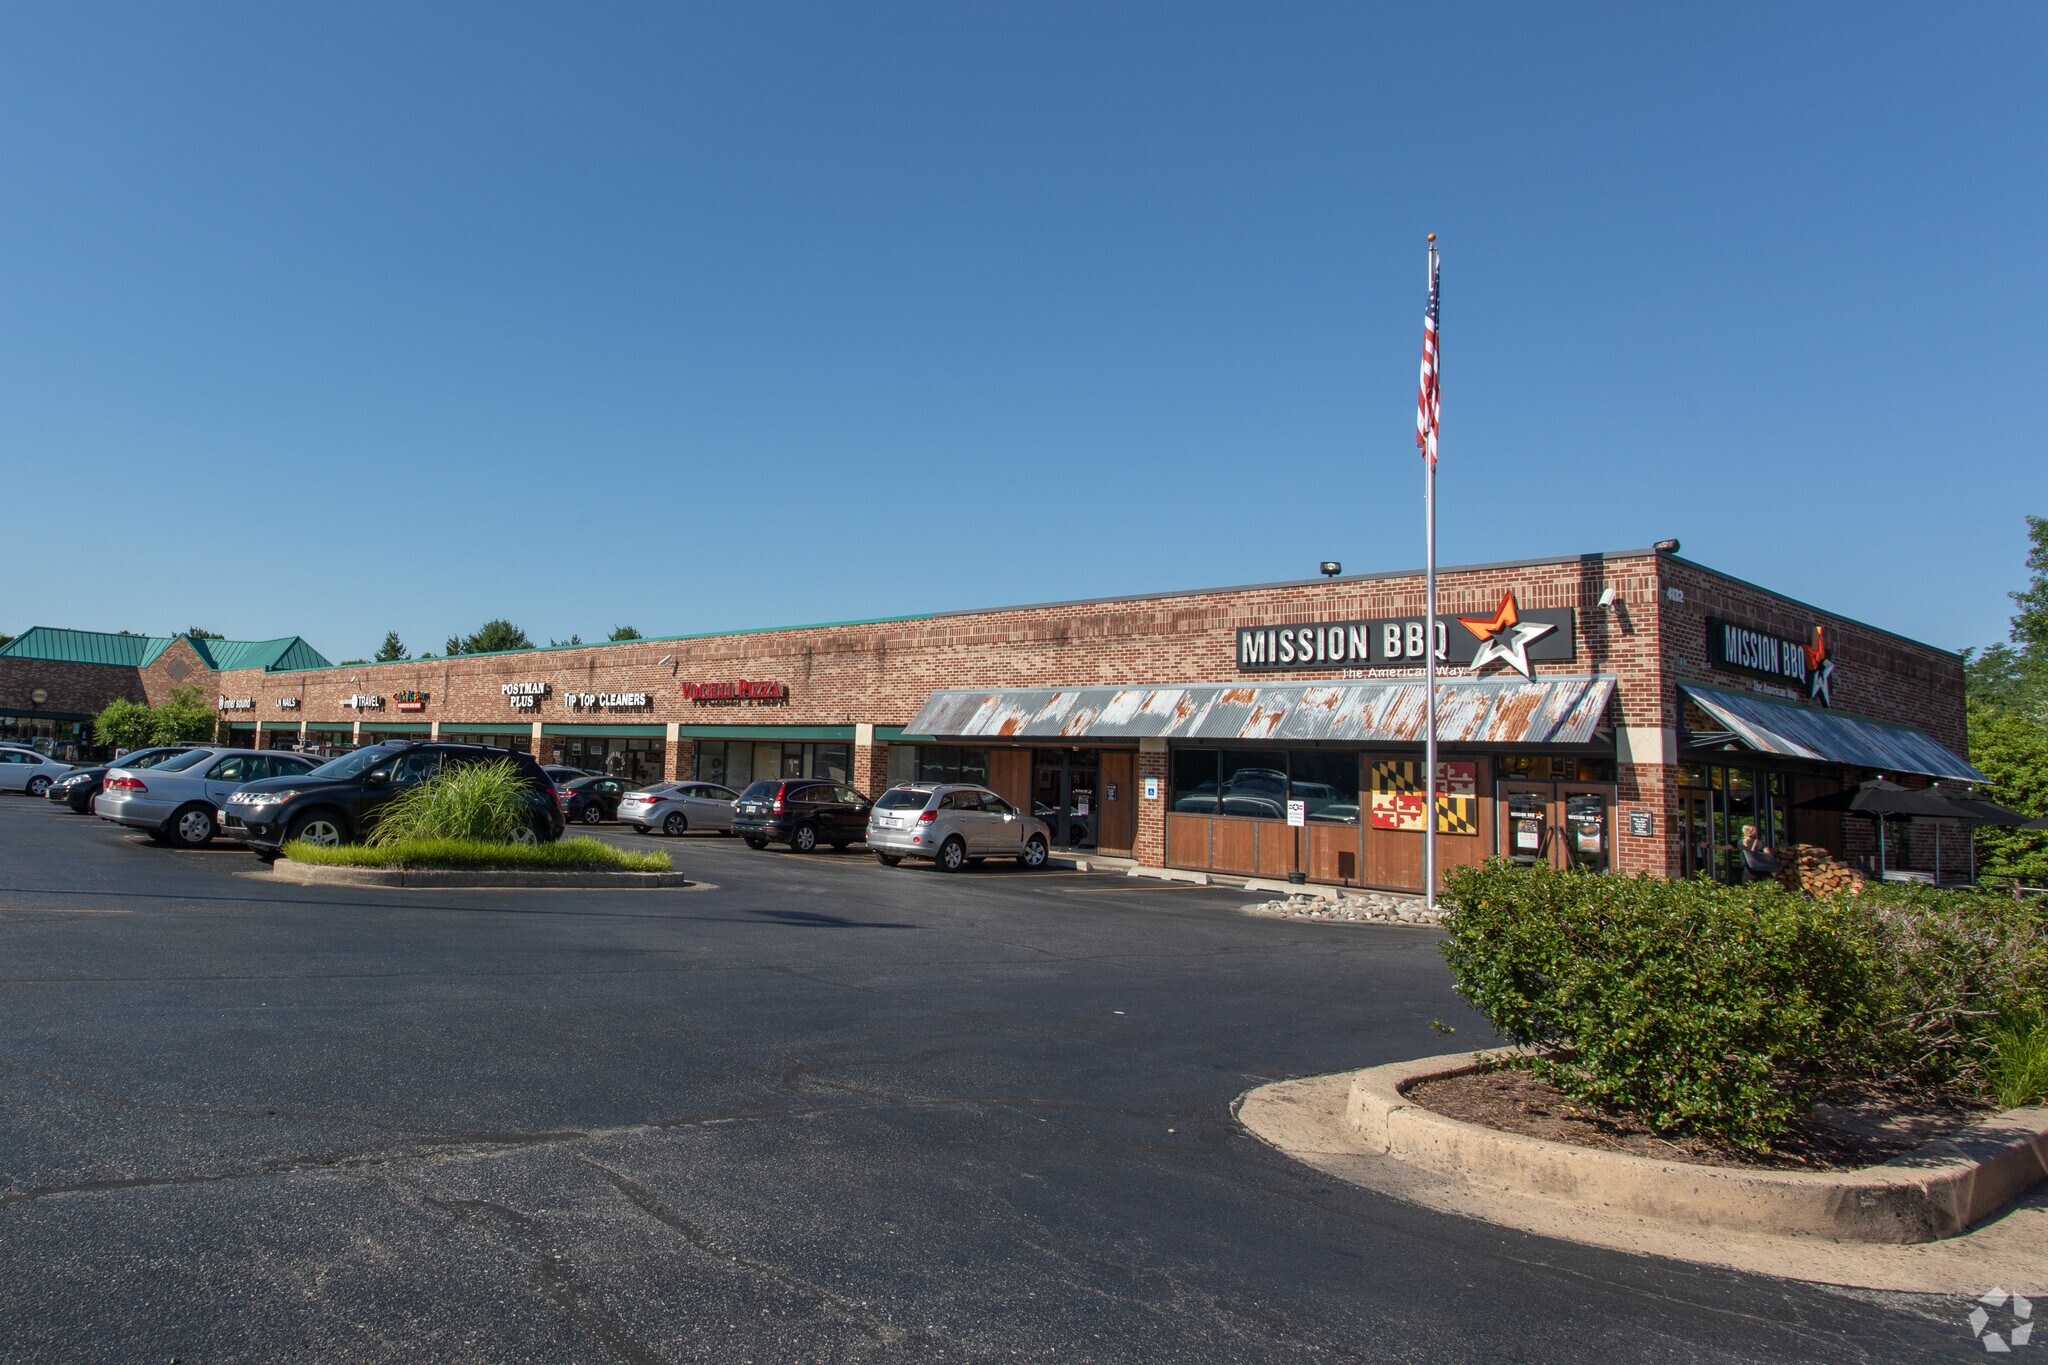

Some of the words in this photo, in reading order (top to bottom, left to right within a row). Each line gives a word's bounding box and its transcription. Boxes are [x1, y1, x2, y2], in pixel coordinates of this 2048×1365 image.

[1242, 624, 1367, 663] MISSION
[1383, 621, 1447, 660] BBQ
[1725, 625, 1779, 673] MISSION
[1782, 640, 1807, 685] BBQ
[501, 682, 546, 695] POSTMAN
[681, 681, 734, 700] VOCELLI
[738, 679, 783, 698] PIZZA
[282, 697, 296, 707] NAILS
[358, 695, 379, 707] TRAVEL
[510, 695, 534, 707] PLUS
[563, 692, 577, 707] TIP
[579, 692, 595, 707] TOP
[599, 692, 646, 706] CLEANERS
